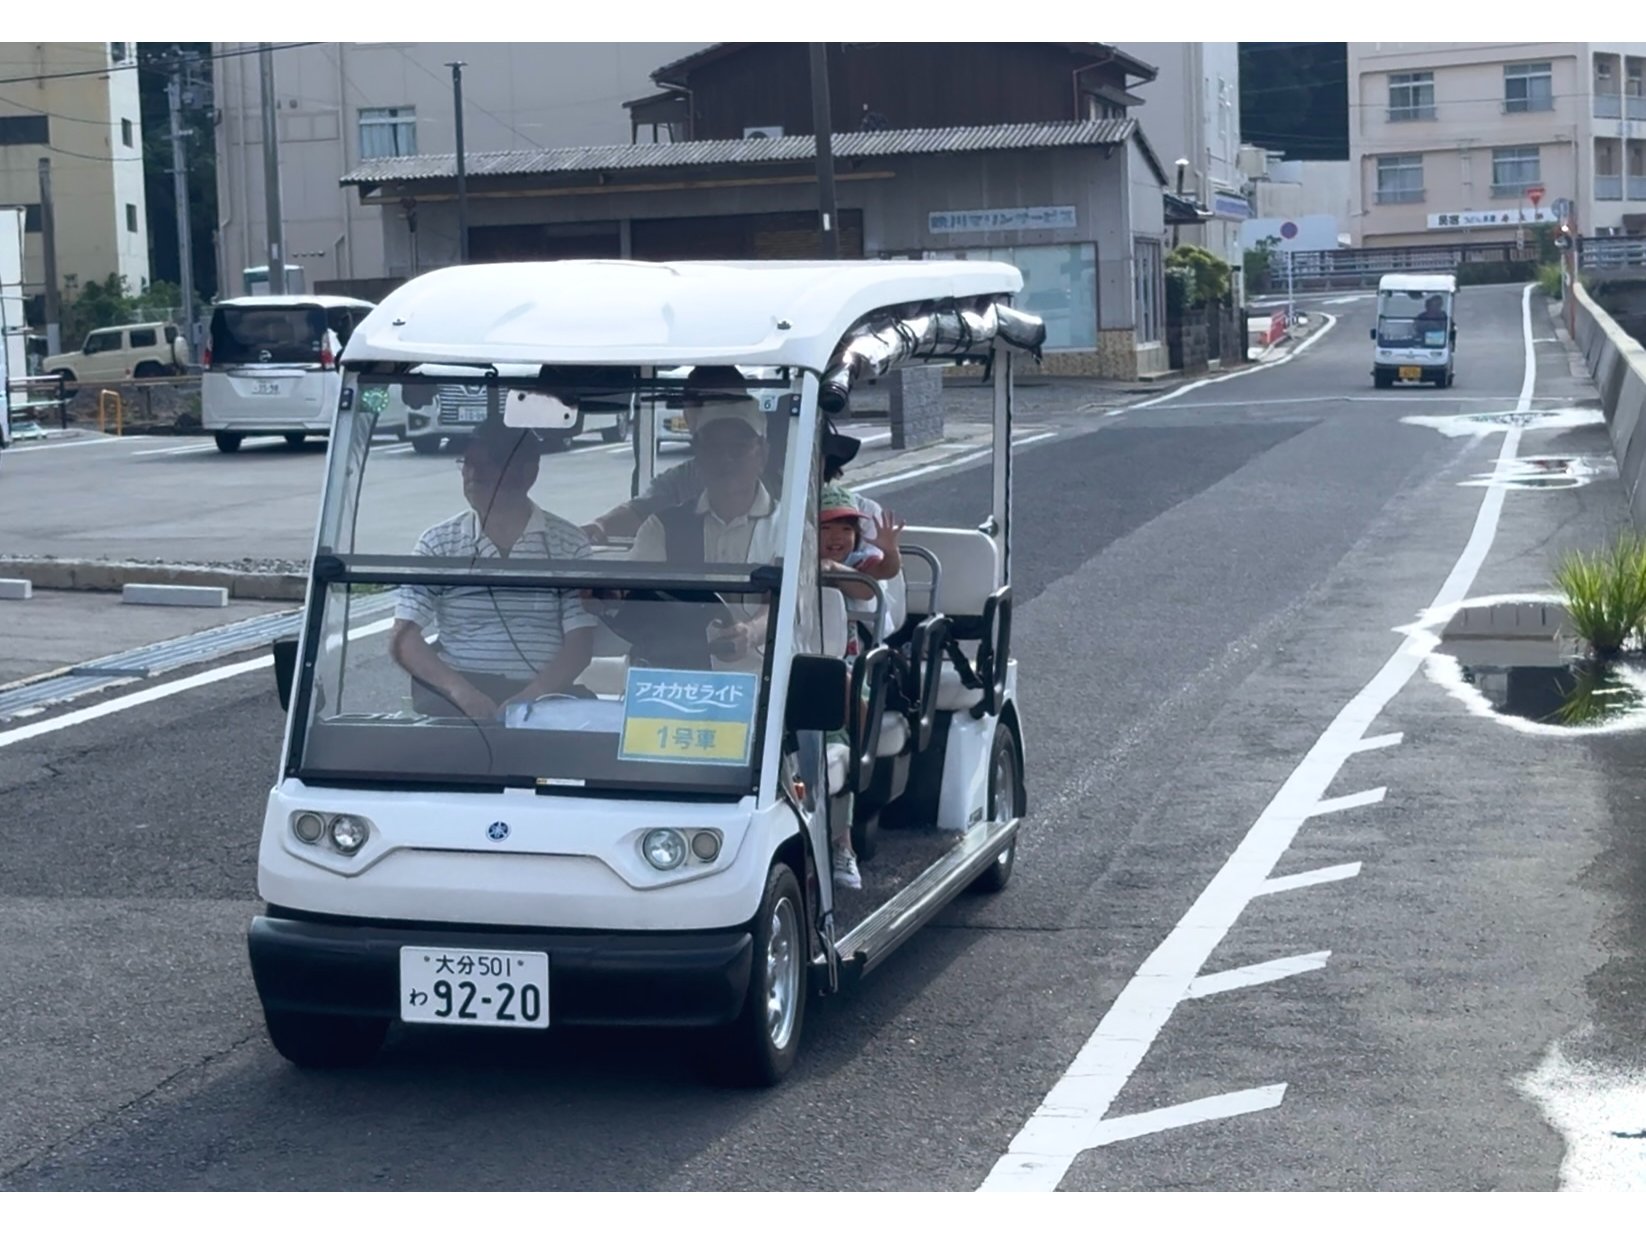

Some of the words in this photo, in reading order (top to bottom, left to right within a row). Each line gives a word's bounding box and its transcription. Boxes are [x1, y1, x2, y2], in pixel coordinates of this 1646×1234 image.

[635, 682, 744, 702] アオカゼライド
[657, 726, 717, 750] 1号車
[435, 955, 511, 977] 大分501
[409, 988, 428, 1006] わ
[433, 980, 540, 1021] 92-20
